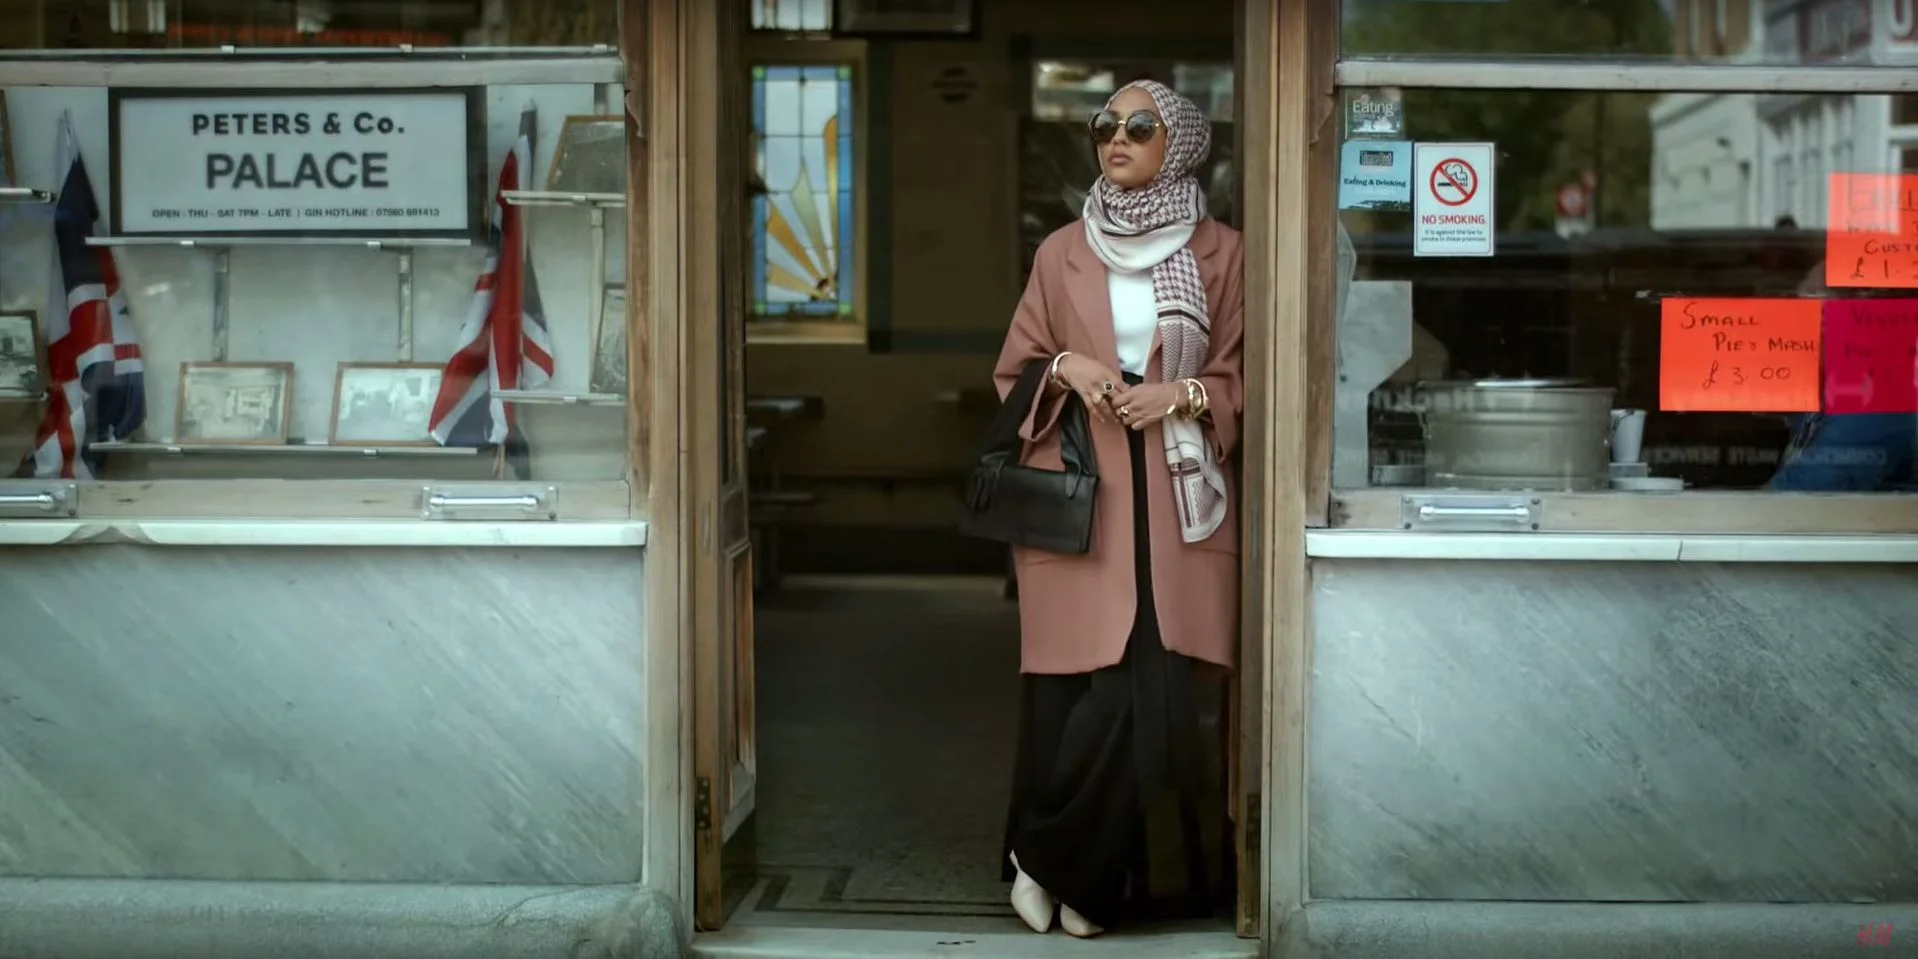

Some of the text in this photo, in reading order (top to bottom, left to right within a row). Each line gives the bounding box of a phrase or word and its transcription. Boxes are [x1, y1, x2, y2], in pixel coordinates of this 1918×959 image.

[1352, 100, 1394, 117] Eating
[192, 111, 405, 136] PETERS & Co.
[206, 151, 389, 190] PALACE
[1343, 177, 1369, 187] Eating
[1375, 179, 1407, 188] Drinking
[151, 208, 181, 218] OPEN
[187, 208, 209, 218] THU
[216, 208, 235, 218] SAT
[237, 208, 260, 218] 7PM
[267, 208, 292, 218] LATE
[304, 208, 323, 218] GIN
[325, 208, 369, 218] HOTLINE
[1422, 214, 1485, 225] NO SMOKING
[1863, 237, 1918, 255] CUST
[1768, 337, 1815, 352] MASH
